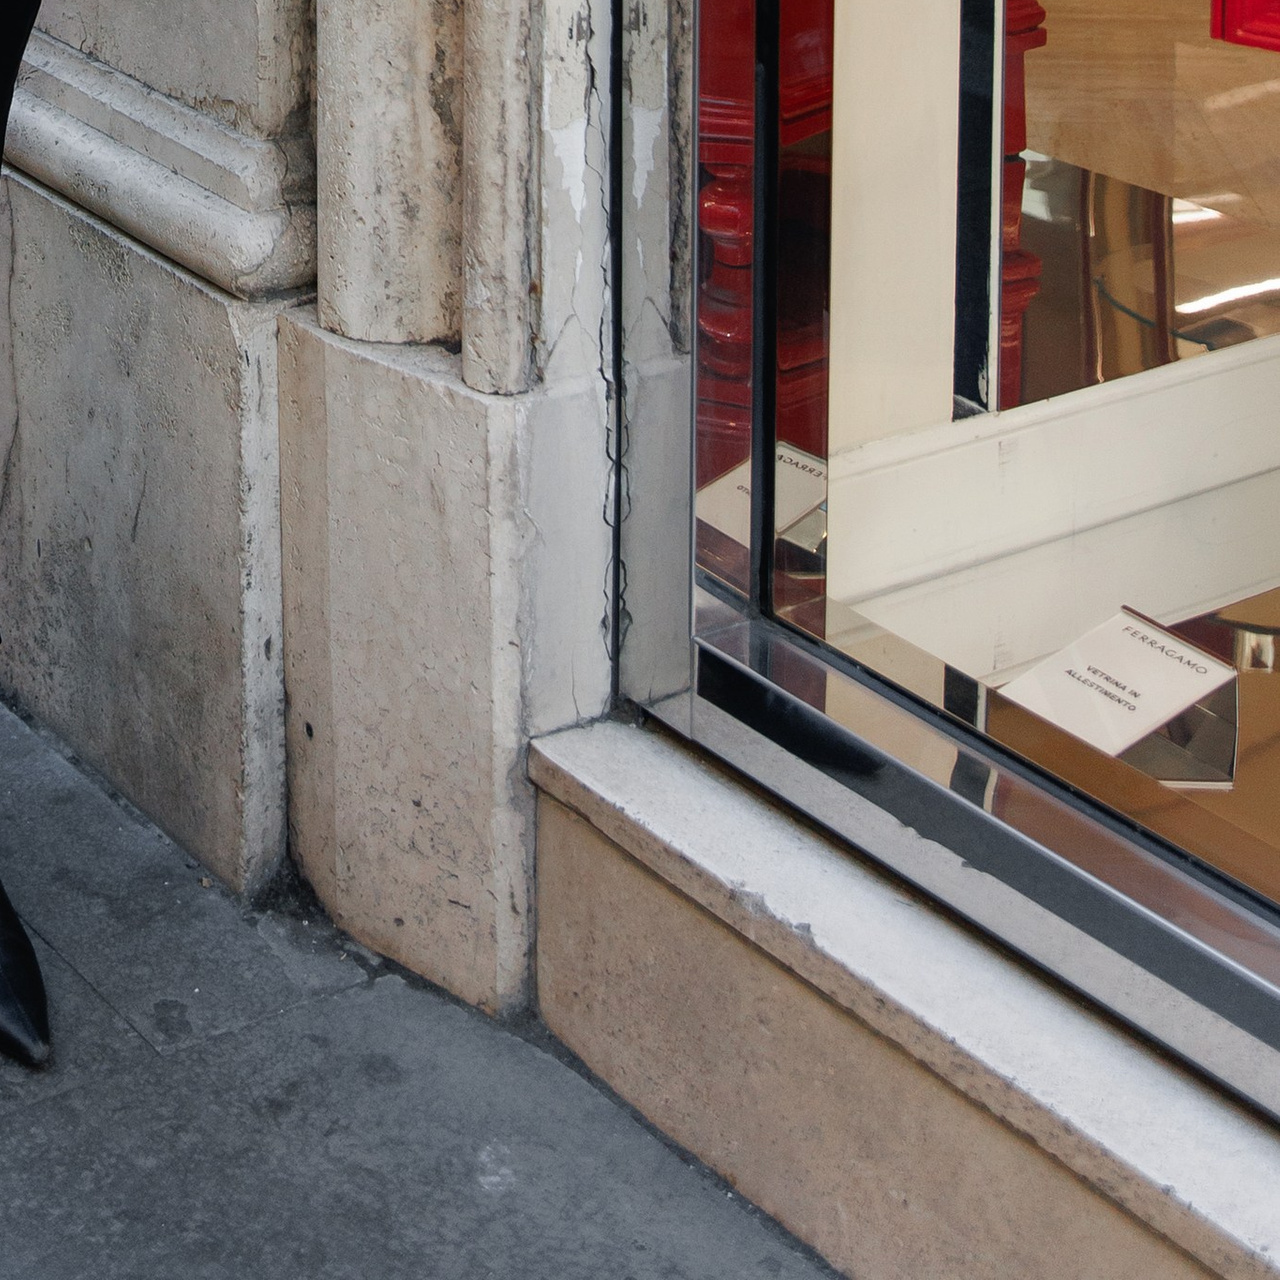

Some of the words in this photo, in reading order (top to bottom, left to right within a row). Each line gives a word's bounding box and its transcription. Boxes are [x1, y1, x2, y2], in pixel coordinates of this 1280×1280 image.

[1121, 625, 1208, 675] FERRAGAMO
[1065, 668, 1136, 712] ALLESTIMENTO
[1086, 665, 1127, 692] VETRINA
[1128, 689, 1141, 699] IN
